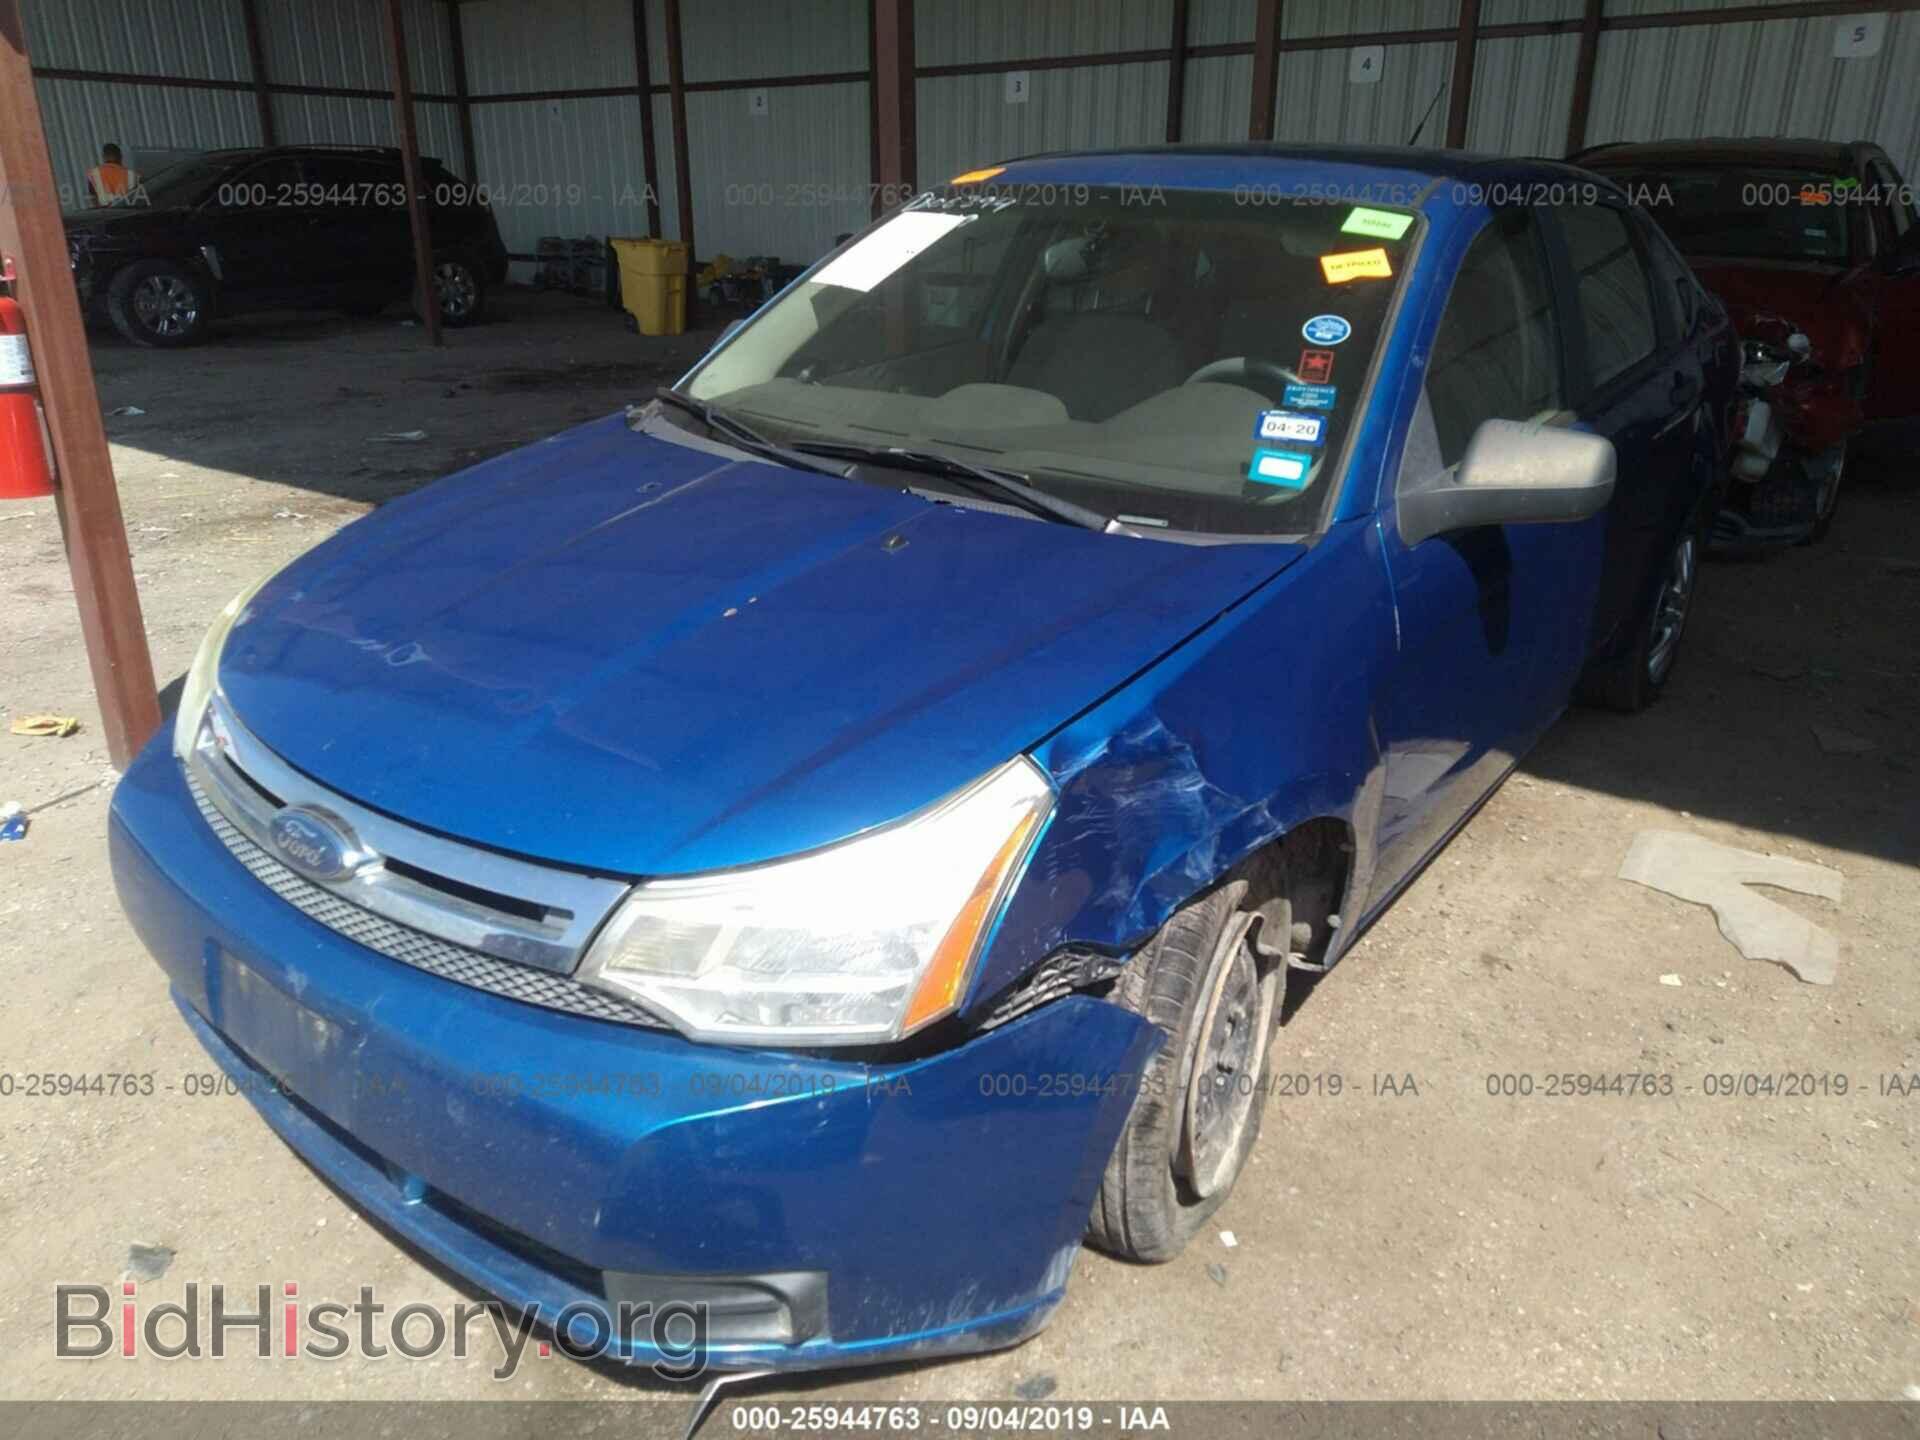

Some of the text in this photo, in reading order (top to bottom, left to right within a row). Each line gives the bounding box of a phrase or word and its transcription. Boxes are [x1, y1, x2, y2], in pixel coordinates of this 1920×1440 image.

[1853, 26, 1866, 42] 5
[1361, 57, 1371, 70] 4
[1015, 80, 1022, 93] 3
[756, 95, 763, 107] 2
[276, 819, 328, 867] Ford
